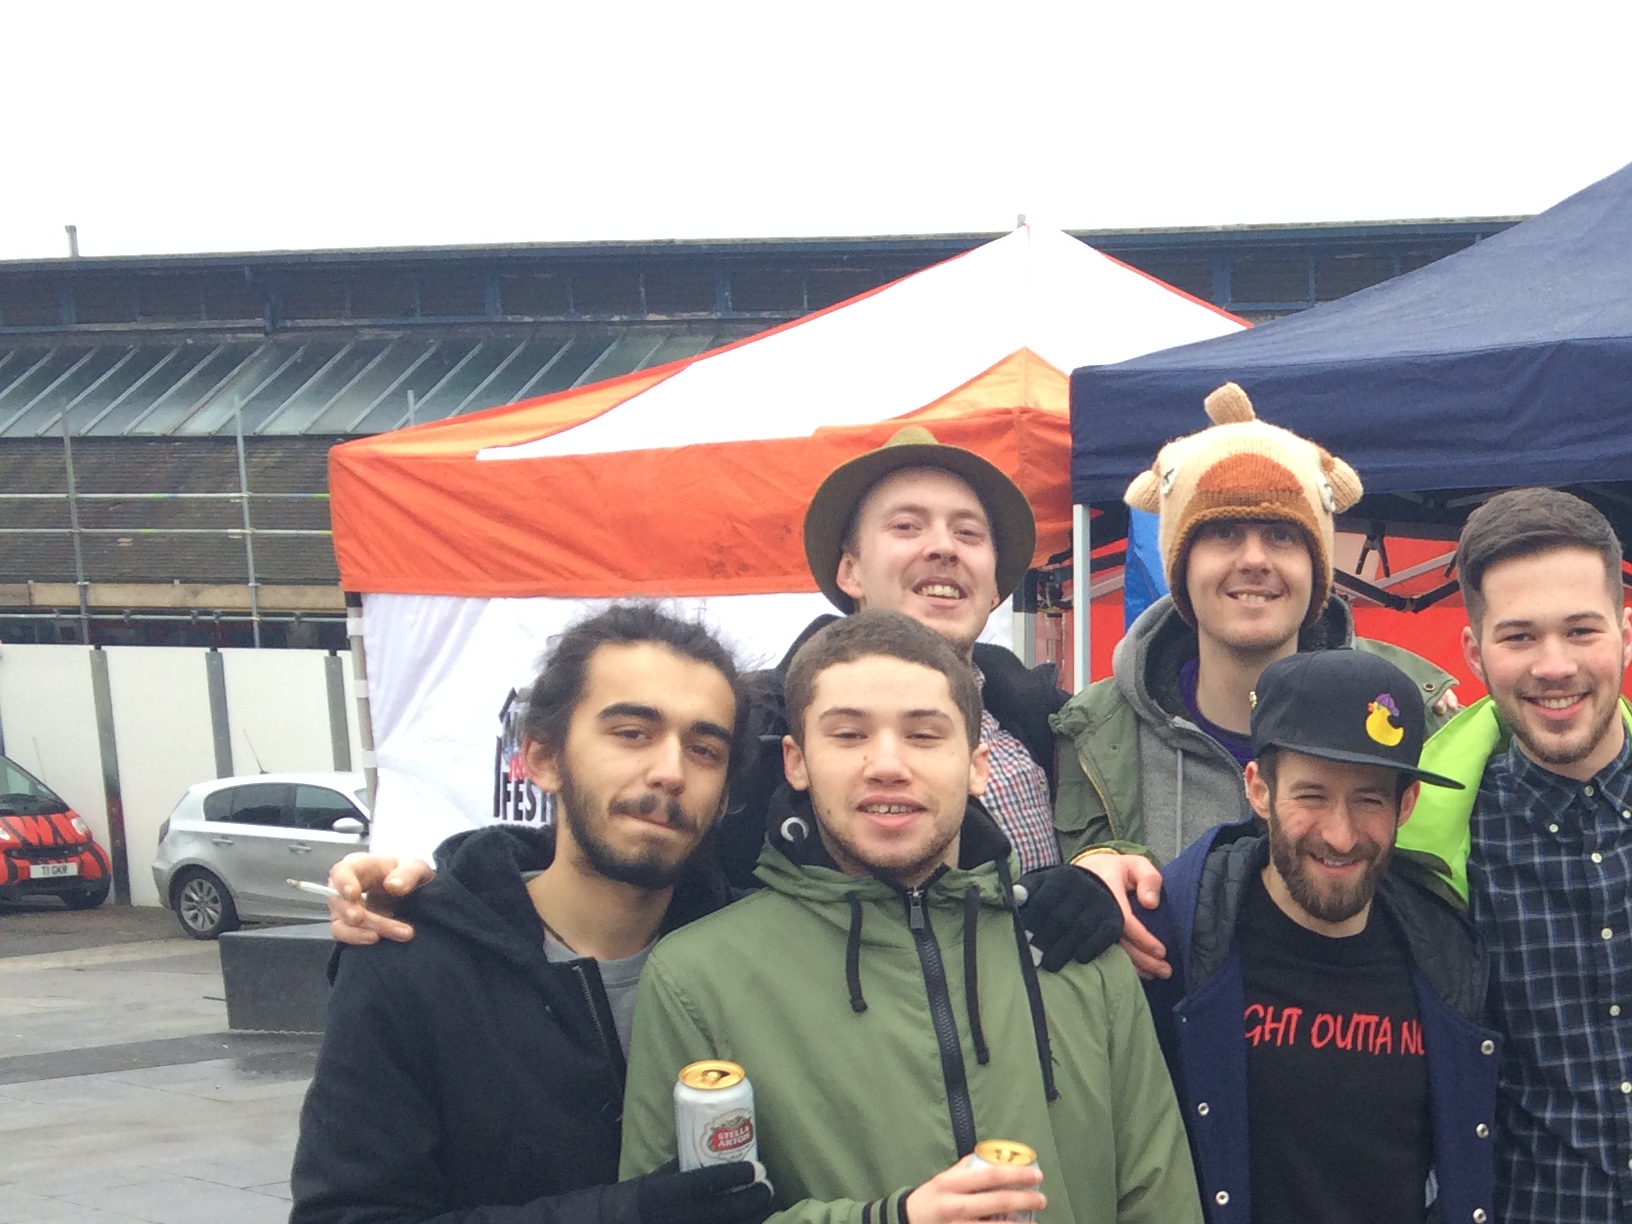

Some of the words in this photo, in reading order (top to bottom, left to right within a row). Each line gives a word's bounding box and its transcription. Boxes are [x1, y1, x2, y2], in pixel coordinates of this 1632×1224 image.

[1244, 1003, 1303, 1047] GHT
[1310, 1012, 1392, 1056] OUTTA
[717, 1125, 750, 1140] STELLA
